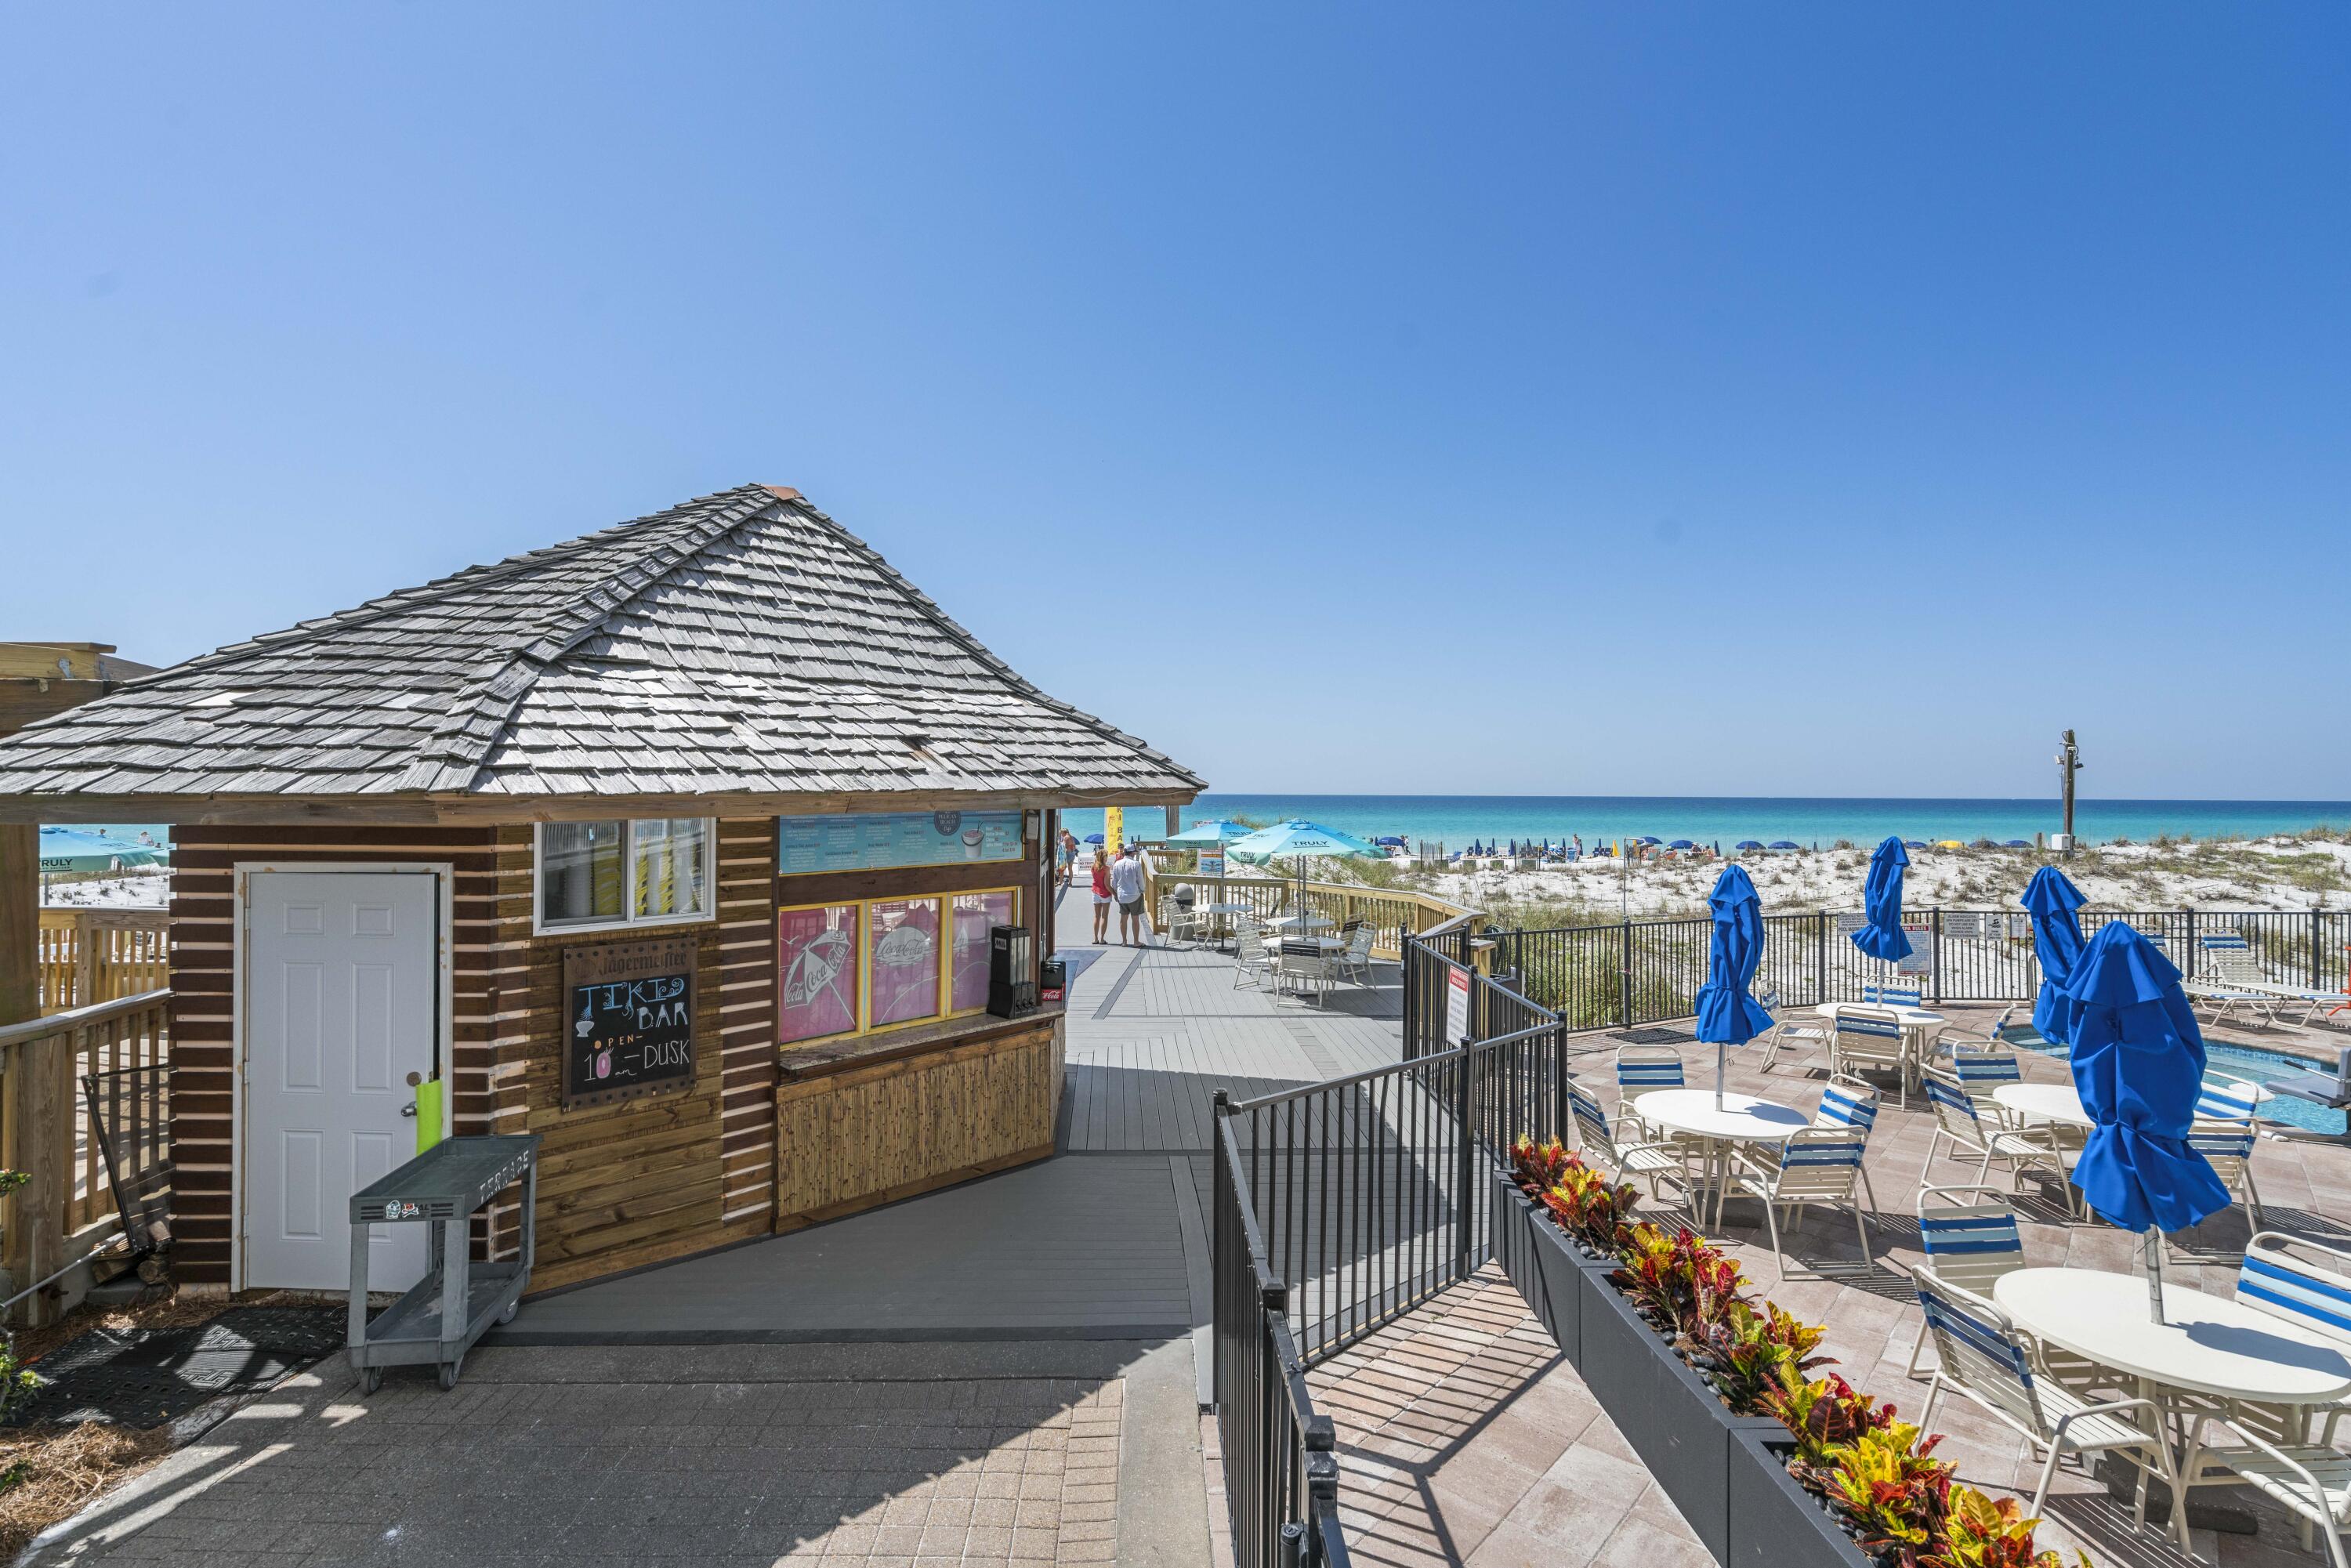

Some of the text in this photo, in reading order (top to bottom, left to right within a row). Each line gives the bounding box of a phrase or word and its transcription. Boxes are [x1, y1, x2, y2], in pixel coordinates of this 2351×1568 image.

[806, 942, 846, 992] Coca Cola
[578, 978, 679, 1014] TIKI
[637, 1002, 688, 1030] BAR
[644, 1040, 690, 1069] DUSK
